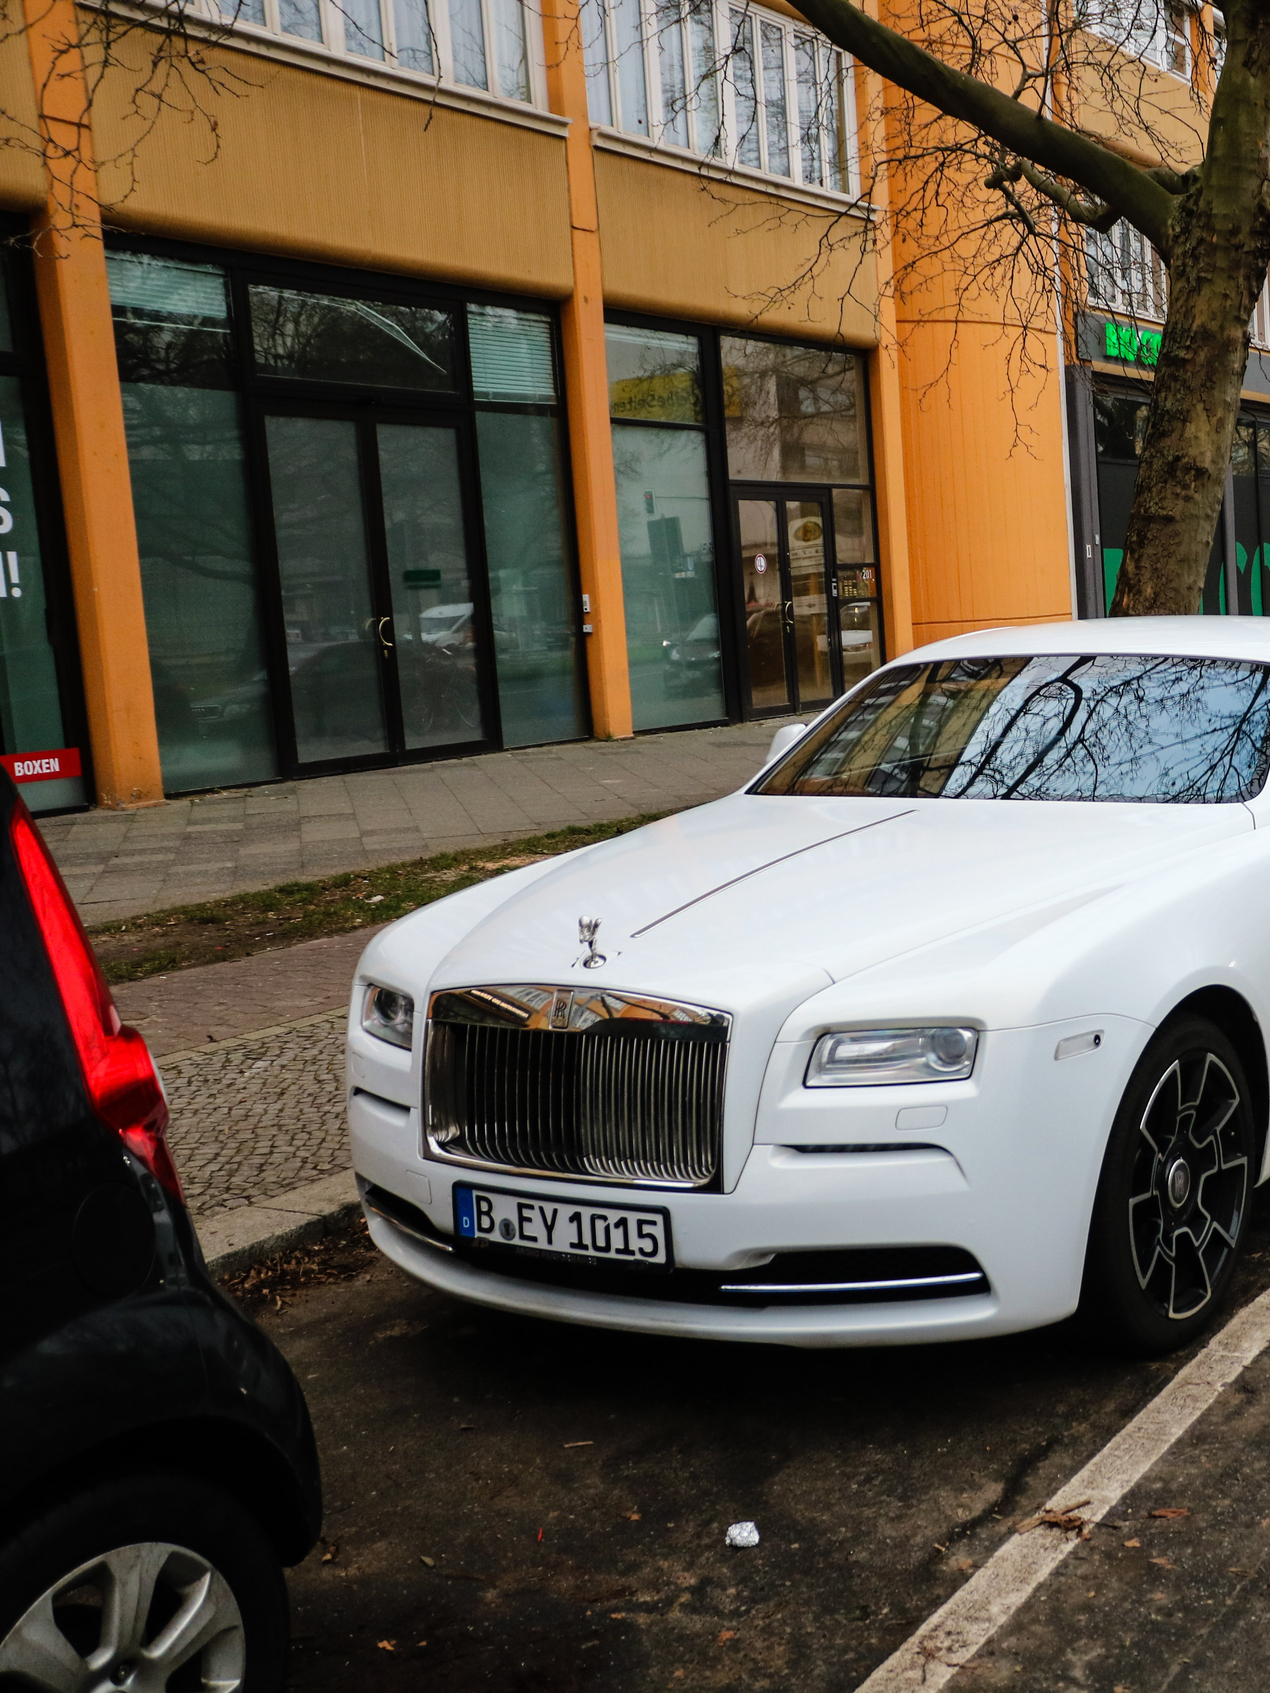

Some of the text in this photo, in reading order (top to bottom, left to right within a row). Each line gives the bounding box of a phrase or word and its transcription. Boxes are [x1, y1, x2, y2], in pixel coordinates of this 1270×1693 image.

[14, 757, 60, 776] BOXEN
[475, 1194, 495, 1234] B
[517, 1202, 558, 1245] EY
[568, 1211, 659, 1258] 1015
